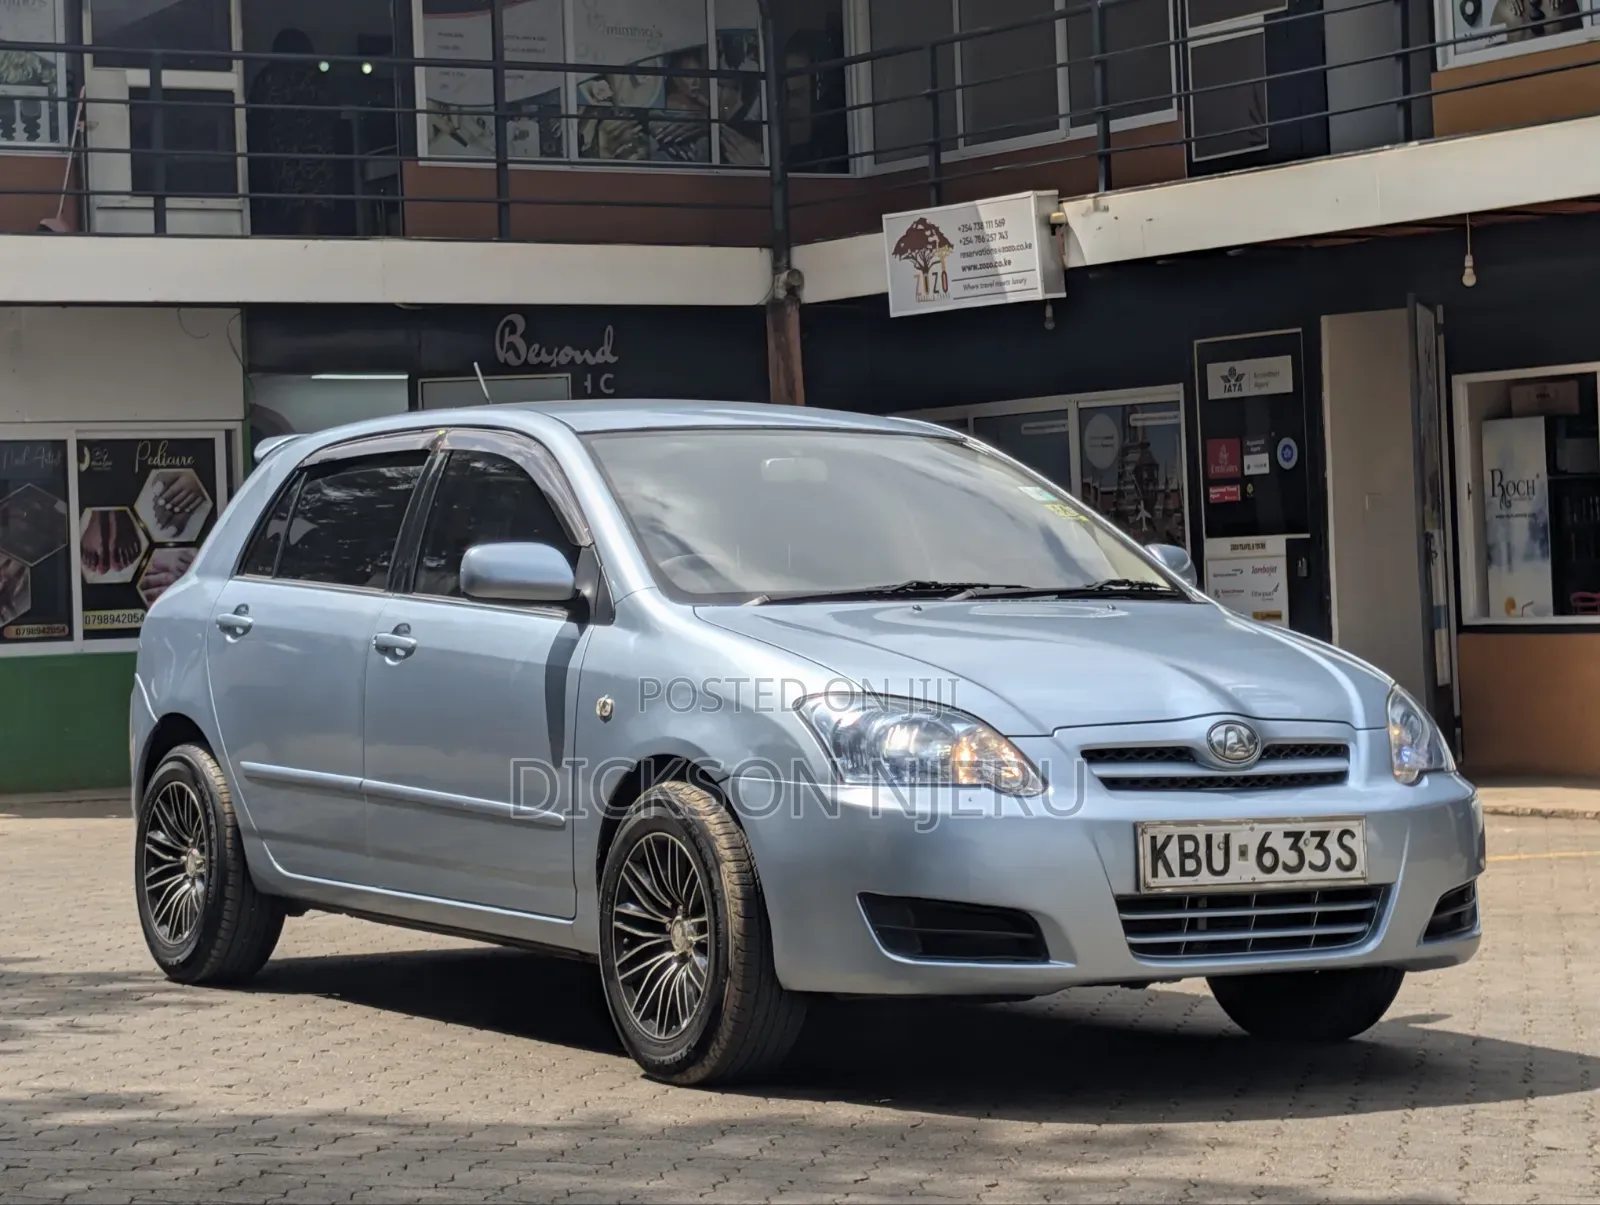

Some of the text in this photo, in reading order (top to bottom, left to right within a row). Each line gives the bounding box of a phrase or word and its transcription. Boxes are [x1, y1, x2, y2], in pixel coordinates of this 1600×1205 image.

[495, 313, 619, 368] Beyond
[1223, 383, 1243, 394] IATA
[135, 440, 195, 473] Pedicure
[84, 612, 145, 625] 0798942054
[1149, 828, 1358, 879] KBU 633S
